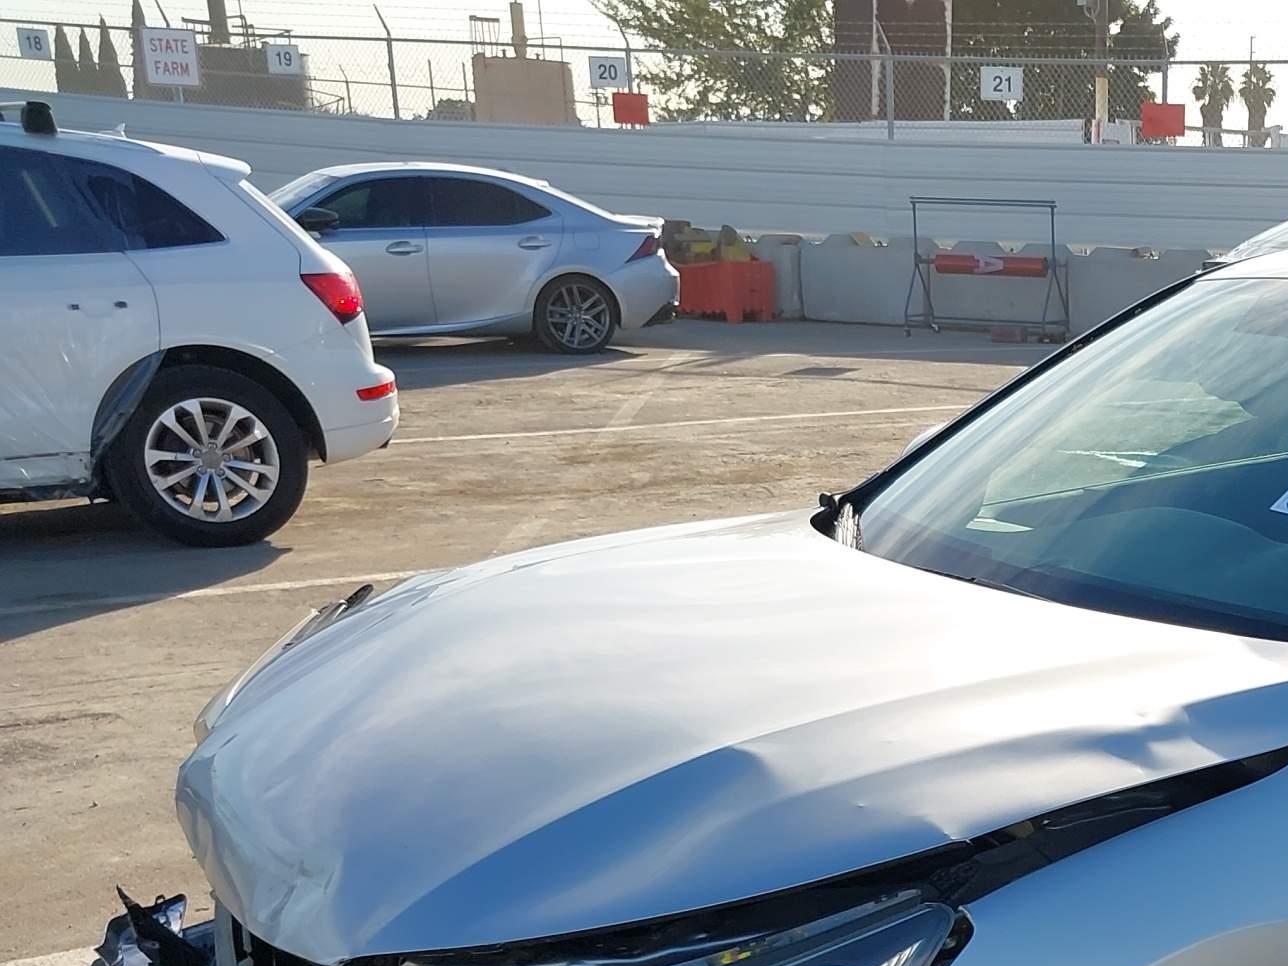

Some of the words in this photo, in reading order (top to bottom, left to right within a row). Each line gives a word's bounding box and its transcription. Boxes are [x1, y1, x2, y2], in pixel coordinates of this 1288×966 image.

[26, 36, 42, 51] 18
[150, 38, 189, 54] STATE
[276, 51, 292, 67] 19
[154, 60, 190, 77] FARM
[598, 64, 618, 80] 20
[993, 75, 1012, 92] 21
